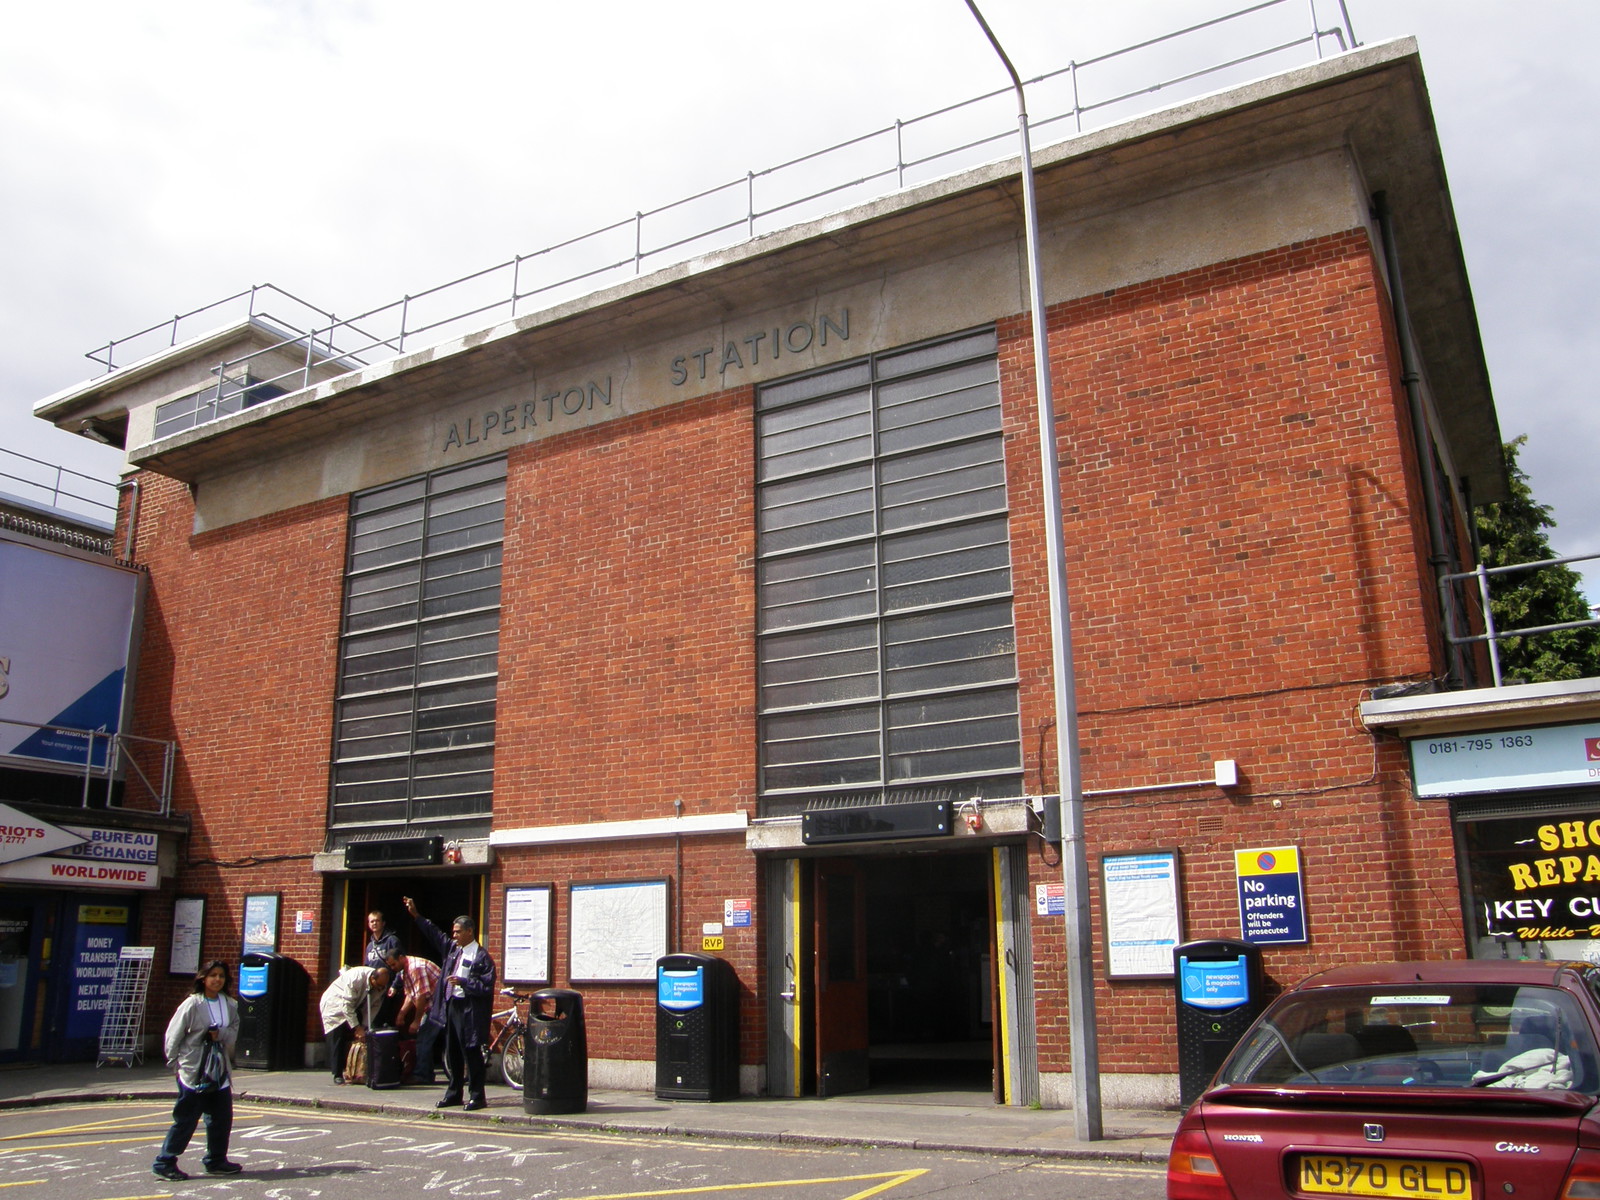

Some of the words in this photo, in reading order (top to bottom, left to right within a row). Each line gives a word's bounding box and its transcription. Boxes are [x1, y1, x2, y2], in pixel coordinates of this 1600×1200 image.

[442, 376, 612, 452] ALPERTON
[670, 308, 850, 386] STATION
[1499, 735, 1533, 749] 1363
[92, 830, 155, 846] BUREAU
[51, 864, 147, 882] WORLDWIDE
[1243, 880, 1265, 893] No
[1245, 893, 1296, 910] parking
[1494, 899, 1553, 919] KEY
[1246, 912, 1284, 920] Offenders
[1247, 920, 1261, 928] will
[1261, 919, 1272, 927] be
[1248, 926, 1289, 937] prosecuted
[87, 937, 113, 948] MONEY
[704, 938, 723, 948] RVP
[80, 952, 118, 963] TRANSFER
[1205, 974, 1240, 982] newspapers
[1211, 980, 1241, 988] magazines
[78, 985, 98, 995] NEXT
[230, 1125, 333, 1142] NO
[1223, 1134, 1264, 1143] HONDA
[1495, 1141, 1540, 1154] Civic
[1303, 1159, 1388, 1190] N370
[1400, 1164, 1466, 1195] GLD
